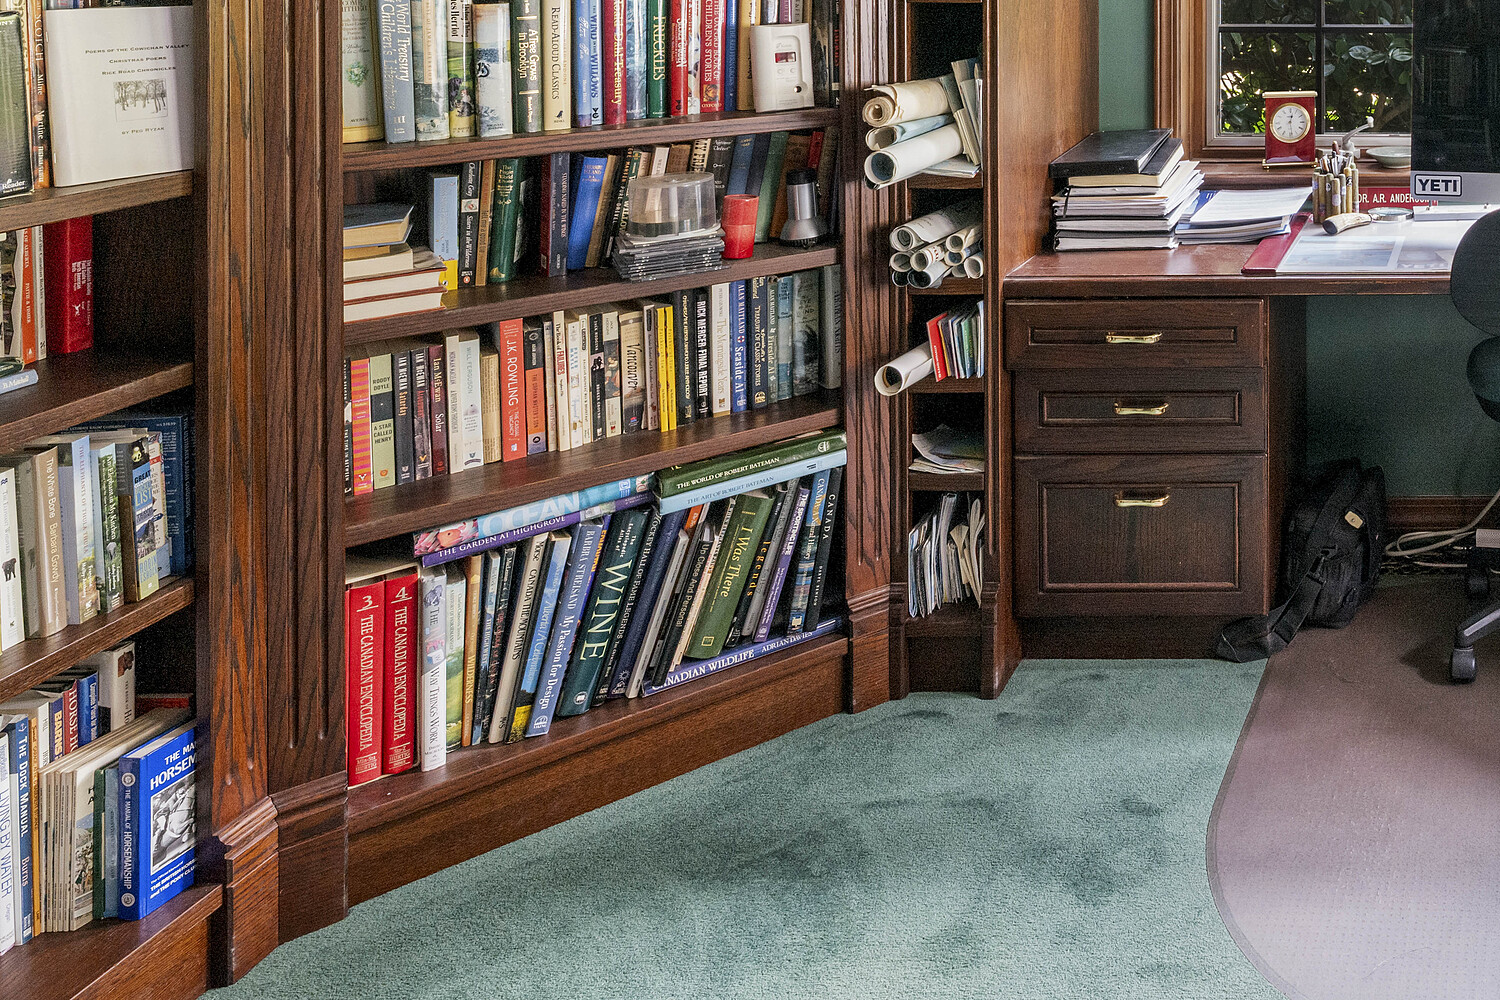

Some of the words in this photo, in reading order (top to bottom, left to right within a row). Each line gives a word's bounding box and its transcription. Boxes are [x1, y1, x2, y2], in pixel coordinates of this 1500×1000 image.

[396, 3, 410, 32] World
[450, 11, 459, 37] Herriot
[590, 14, 598, 40] WIND
[528, 36, 538, 53] Tree
[552, 7, 560, 63] READ-ALOUD
[137, 65, 176, 73] CHRONICLES
[398, 34, 410, 82] Treasury
[529, 54, 539, 81] Grows
[552, 63, 560, 100] CLASSICS
[590, 53, 599, 99] WILLOWS
[611, 60, 624, 106] Treasury
[1, 179, 26, 190] Reader
[1373, 193, 1388, 203] A.R.
[1418, 179, 1459, 192] YETI
[696, 301, 706, 316] RICK
[697, 318, 707, 347] MERCER
[506, 339, 514, 356] J.K.
[698, 349, 707, 368] FINAL
[372, 376, 391, 385] RODDY
[627, 343, 642, 391] Vancouver
[373, 383, 390, 391] DOYLE
[434, 372, 443, 403] McEwan
[507, 357, 519, 407] ROWLING
[698, 369, 708, 397] REPORT
[373, 430, 393, 438] CALLED
[435, 413, 445, 432] Solar
[374, 436, 392, 445] HENRY
[46, 459, 54, 475] The
[134, 469, 151, 484] GREAT
[691, 474, 715, 485] WORLD
[724, 466, 749, 477] ROBERT
[749, 457, 780, 469] BATEMAN
[47, 476, 55, 497] White
[135, 489, 152, 507] LIST
[48, 497, 56, 518] Bone
[823, 494, 836, 539] CANADA
[49, 522, 59, 551] Barbara
[438, 548, 456, 557] THE
[459, 535, 497, 551] GARDEN
[499, 532, 509, 540] AT
[513, 516, 566, 537] HIGHGROVE
[579, 530, 595, 562] BARBRA
[699, 543, 710, 555] Up
[731, 536, 751, 562] Was
[51, 553, 60, 584] Gowdy
[692, 555, 706, 577] Close
[396, 587, 407, 599] 4
[568, 564, 587, 610] STREISAND
[688, 579, 698, 594] And
[720, 564, 742, 598] There
[363, 596, 372, 607] 3
[580, 560, 633, 661] WINE
[675, 593, 693, 628] Personal
[360, 615, 373, 634] THE
[395, 606, 407, 626] THE
[563, 615, 574, 629] My
[360, 635, 373, 682] CANADIAN
[394, 626, 407, 673] CANADIAN
[553, 628, 572, 664] Passion
[430, 667, 440, 687] WAY
[549, 663, 563, 679] for
[394, 674, 407, 741] ENCYCLOPEDIA
[430, 688, 440, 716] THINGS
[539, 678, 559, 710] Design
[360, 683, 373, 751] ENCYCLOPEDIA
[429, 717, 440, 744] WORK
[18, 737, 28, 758] THE
[164, 750, 180, 766] THE
[19, 760, 29, 789] DOCK
[20, 792, 29, 837] MANUAL
[21, 856, 30, 888] Burns
[123, 831, 132, 890] HORSEMANSHIP
